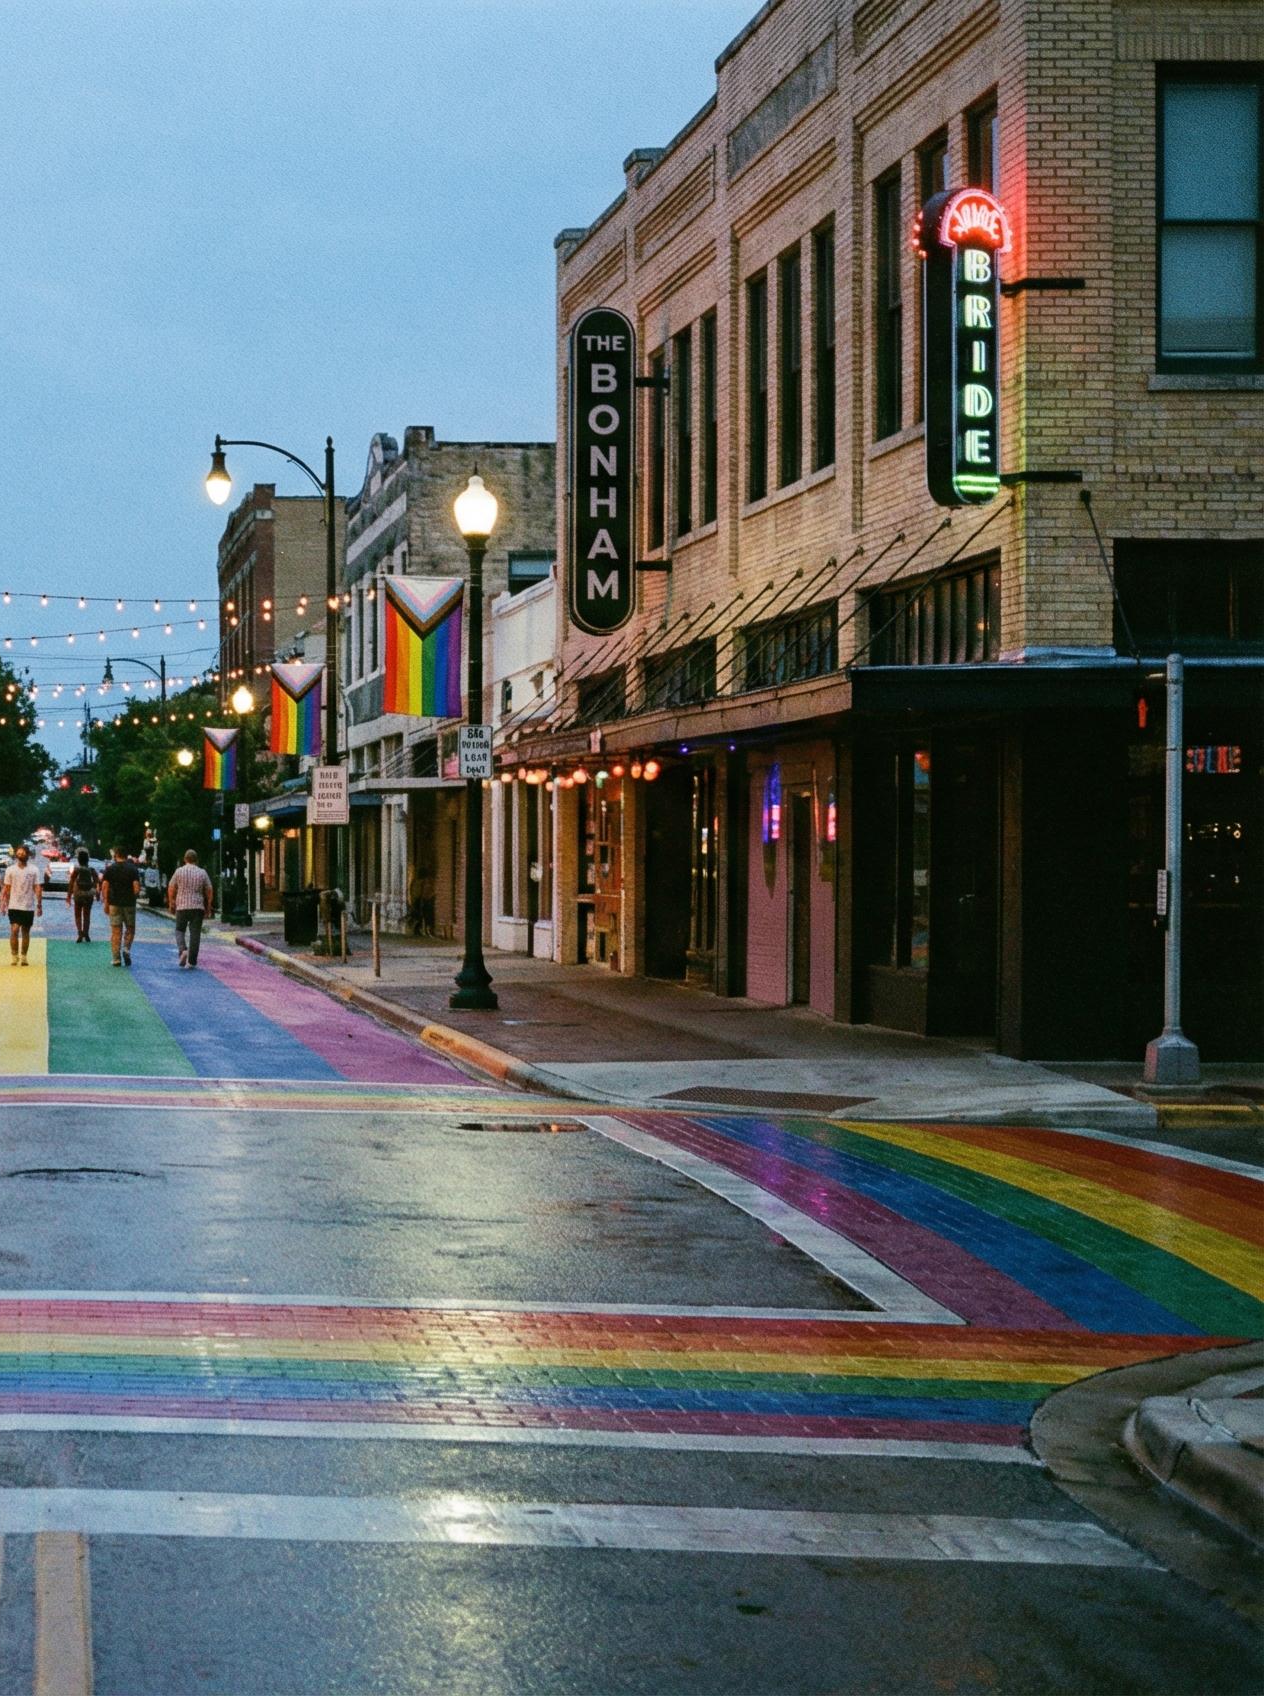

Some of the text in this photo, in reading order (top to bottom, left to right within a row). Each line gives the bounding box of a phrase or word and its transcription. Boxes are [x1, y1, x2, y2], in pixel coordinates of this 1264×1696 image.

[581, 335, 626, 352] THE
[964, 249, 993, 463] BRIDE
[587, 363, 620, 600] BONHAM
